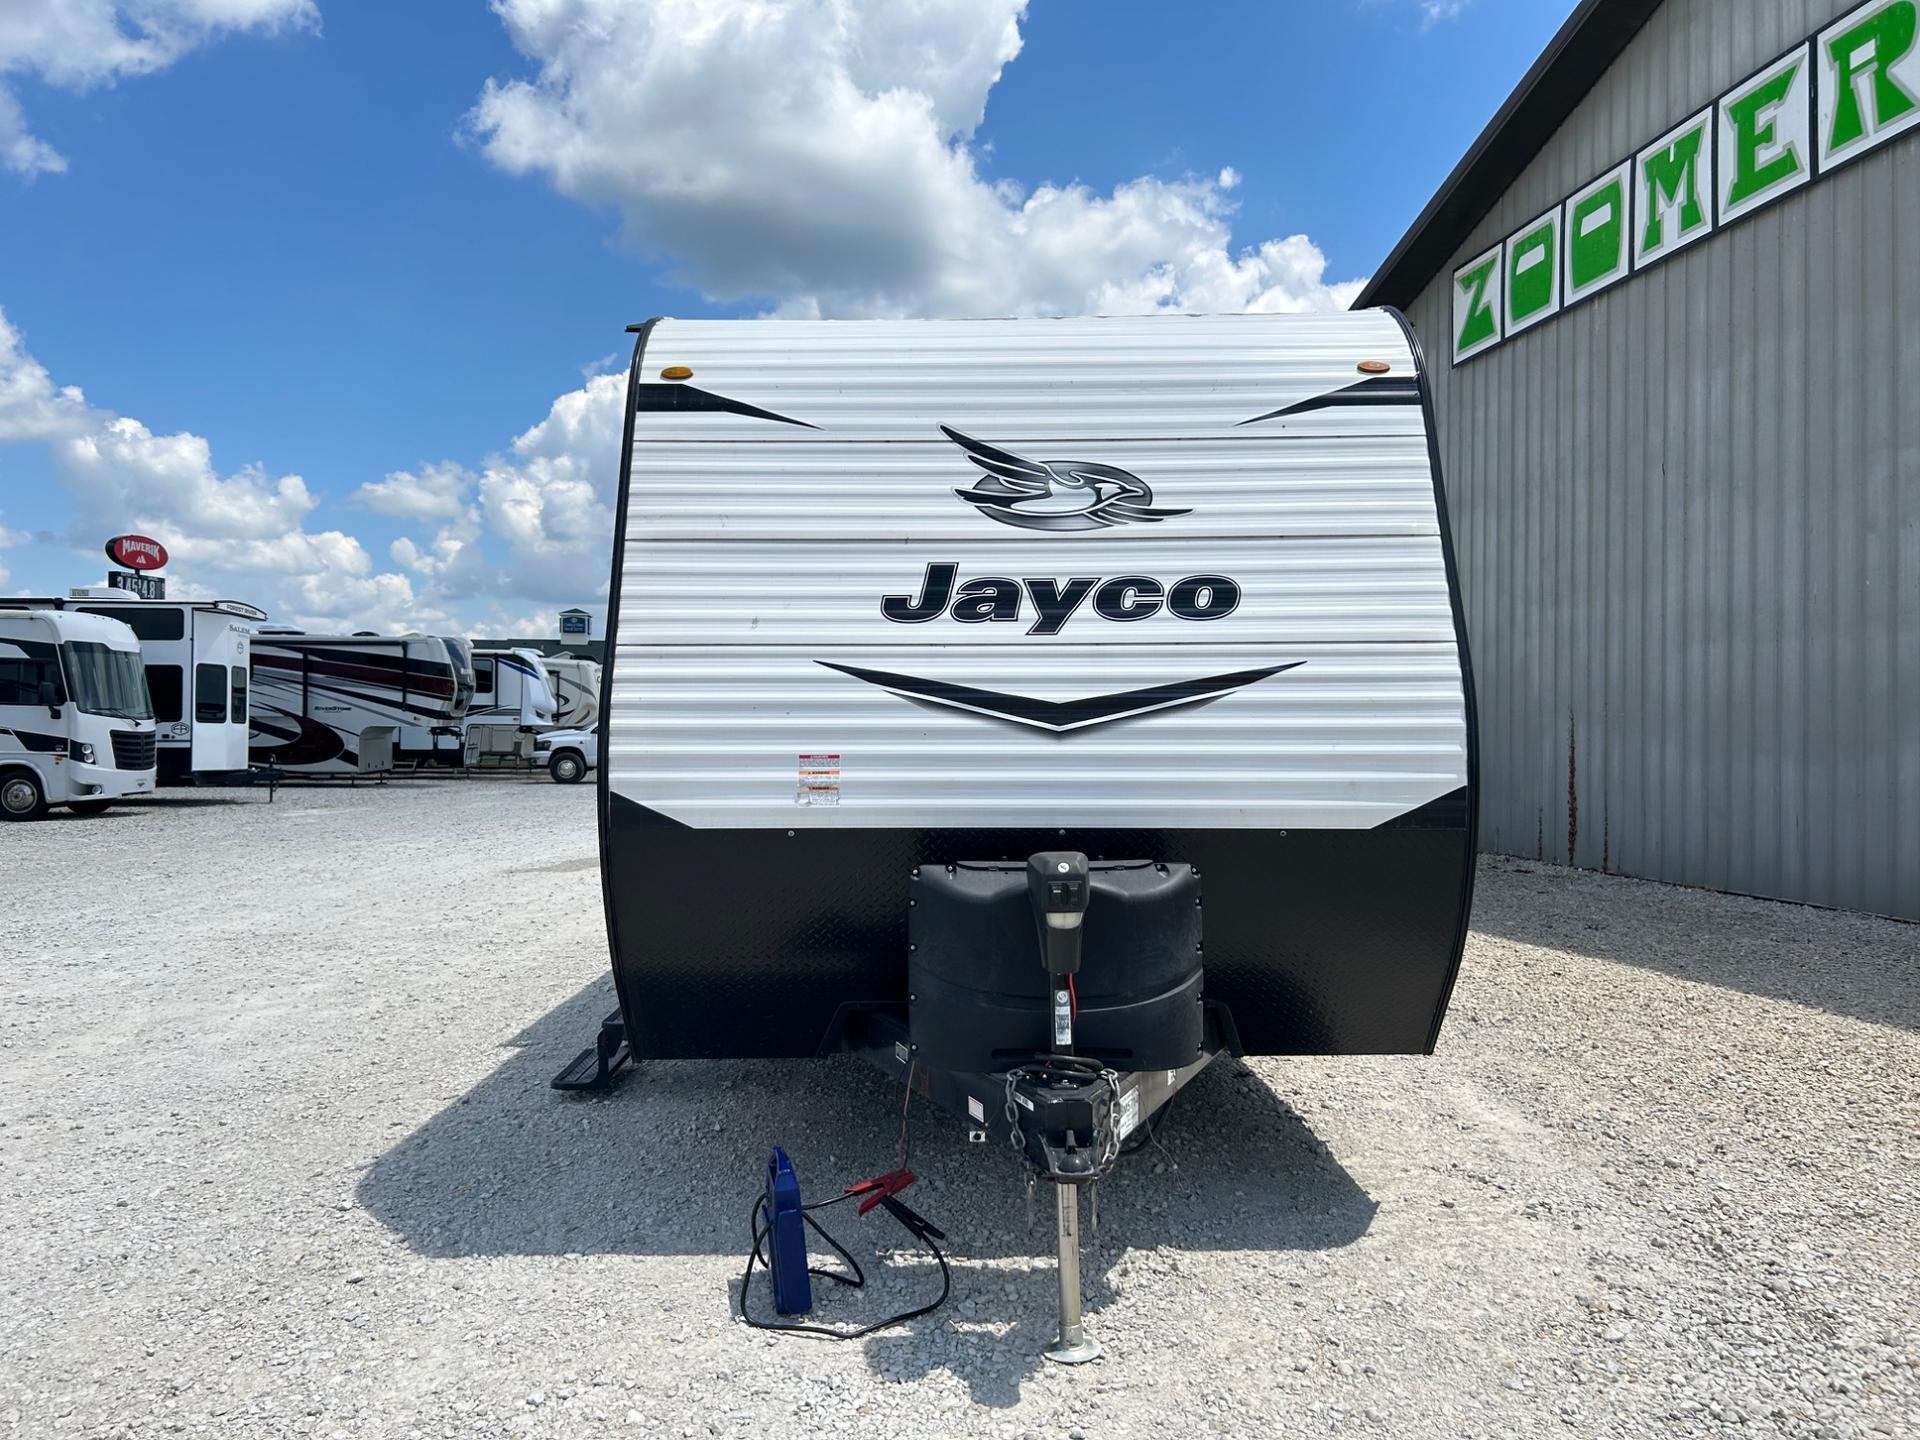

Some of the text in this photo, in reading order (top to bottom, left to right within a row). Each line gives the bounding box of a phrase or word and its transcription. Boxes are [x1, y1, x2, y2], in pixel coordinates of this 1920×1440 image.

[1456, 0, 1920, 353] ZOOMER
[122, 539, 160, 562] MAVERIK
[880, 562, 1241, 635] Jayco
